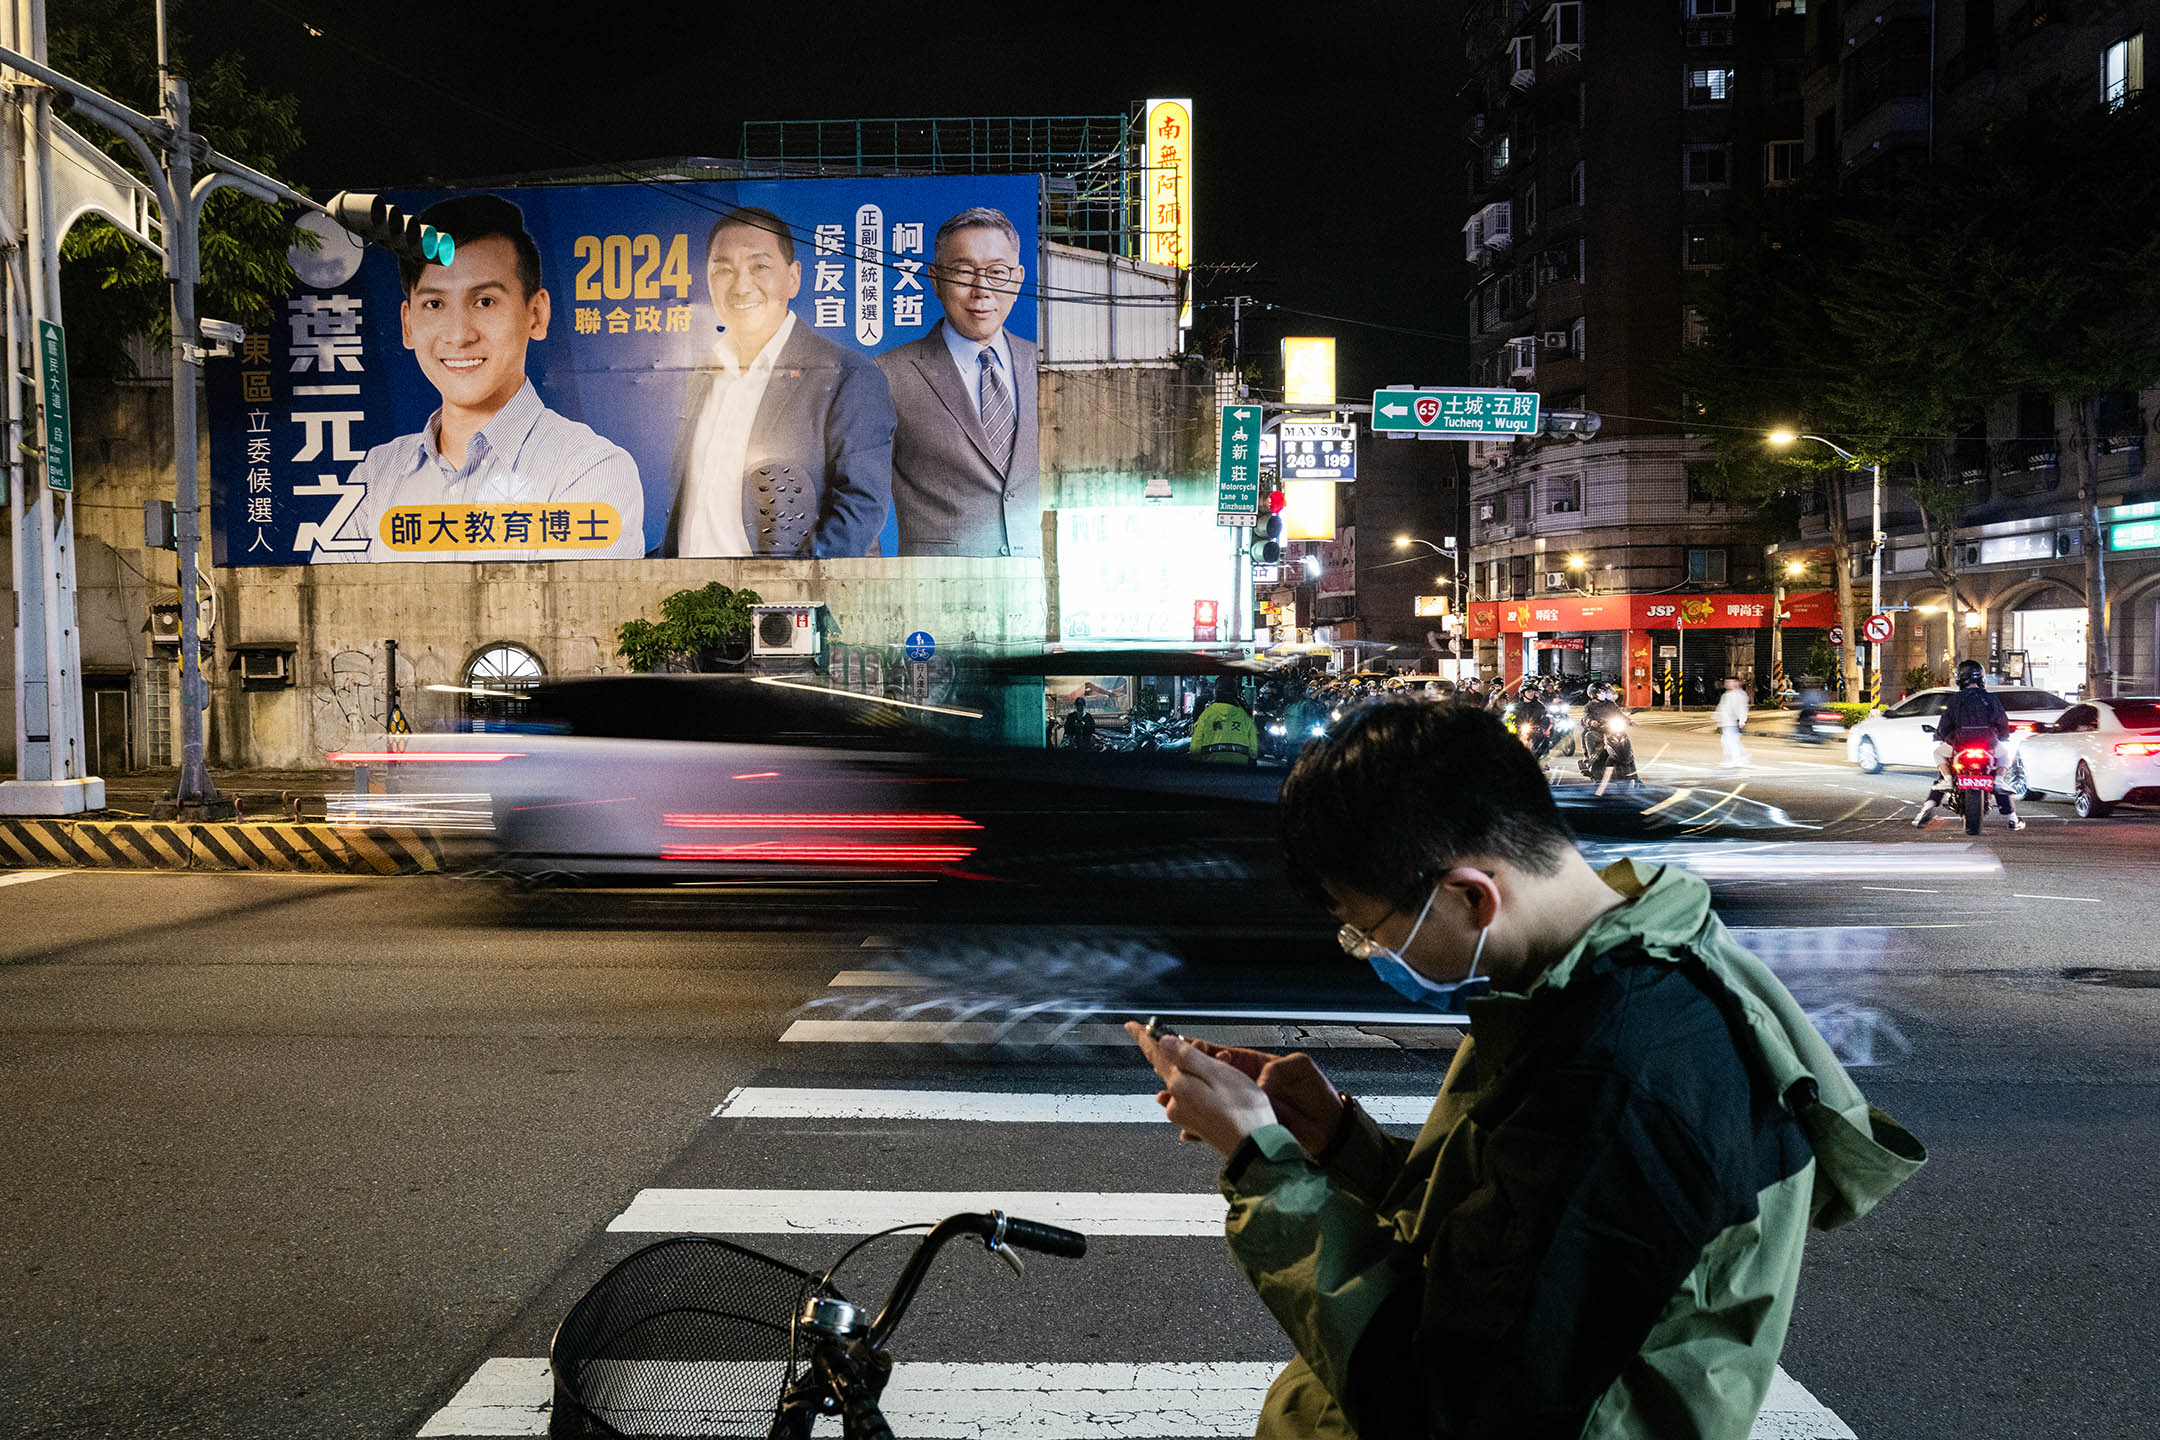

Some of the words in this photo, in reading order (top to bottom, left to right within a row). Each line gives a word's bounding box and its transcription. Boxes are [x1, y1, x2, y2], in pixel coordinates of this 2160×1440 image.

[1156, 115, 1182, 268] 南無阿彌陀
[574, 233, 692, 301] 2024
[814, 224, 846, 328] 侯友宜
[861, 210, 878, 339] 正副總統候選人
[892, 222, 924, 326] 柯文哲
[574, 305, 692, 335] 聯合政府
[287, 294, 373, 553] 葉元之
[1419, 403, 1437, 416] 65
[1443, 416, 1484, 431] Tucheng
[1495, 417, 1528, 432] Wugu
[1231, 443, 1249, 481] 新莊
[1286, 454, 1316, 468] 249
[1324, 454, 1351, 468] 199
[1220, 483, 1256, 492] Motorcycle
[1220, 503, 1255, 512] Xinzhuang
[391, 509, 609, 545] 師大教育博士
[1646, 605, 1676, 617] JSP
